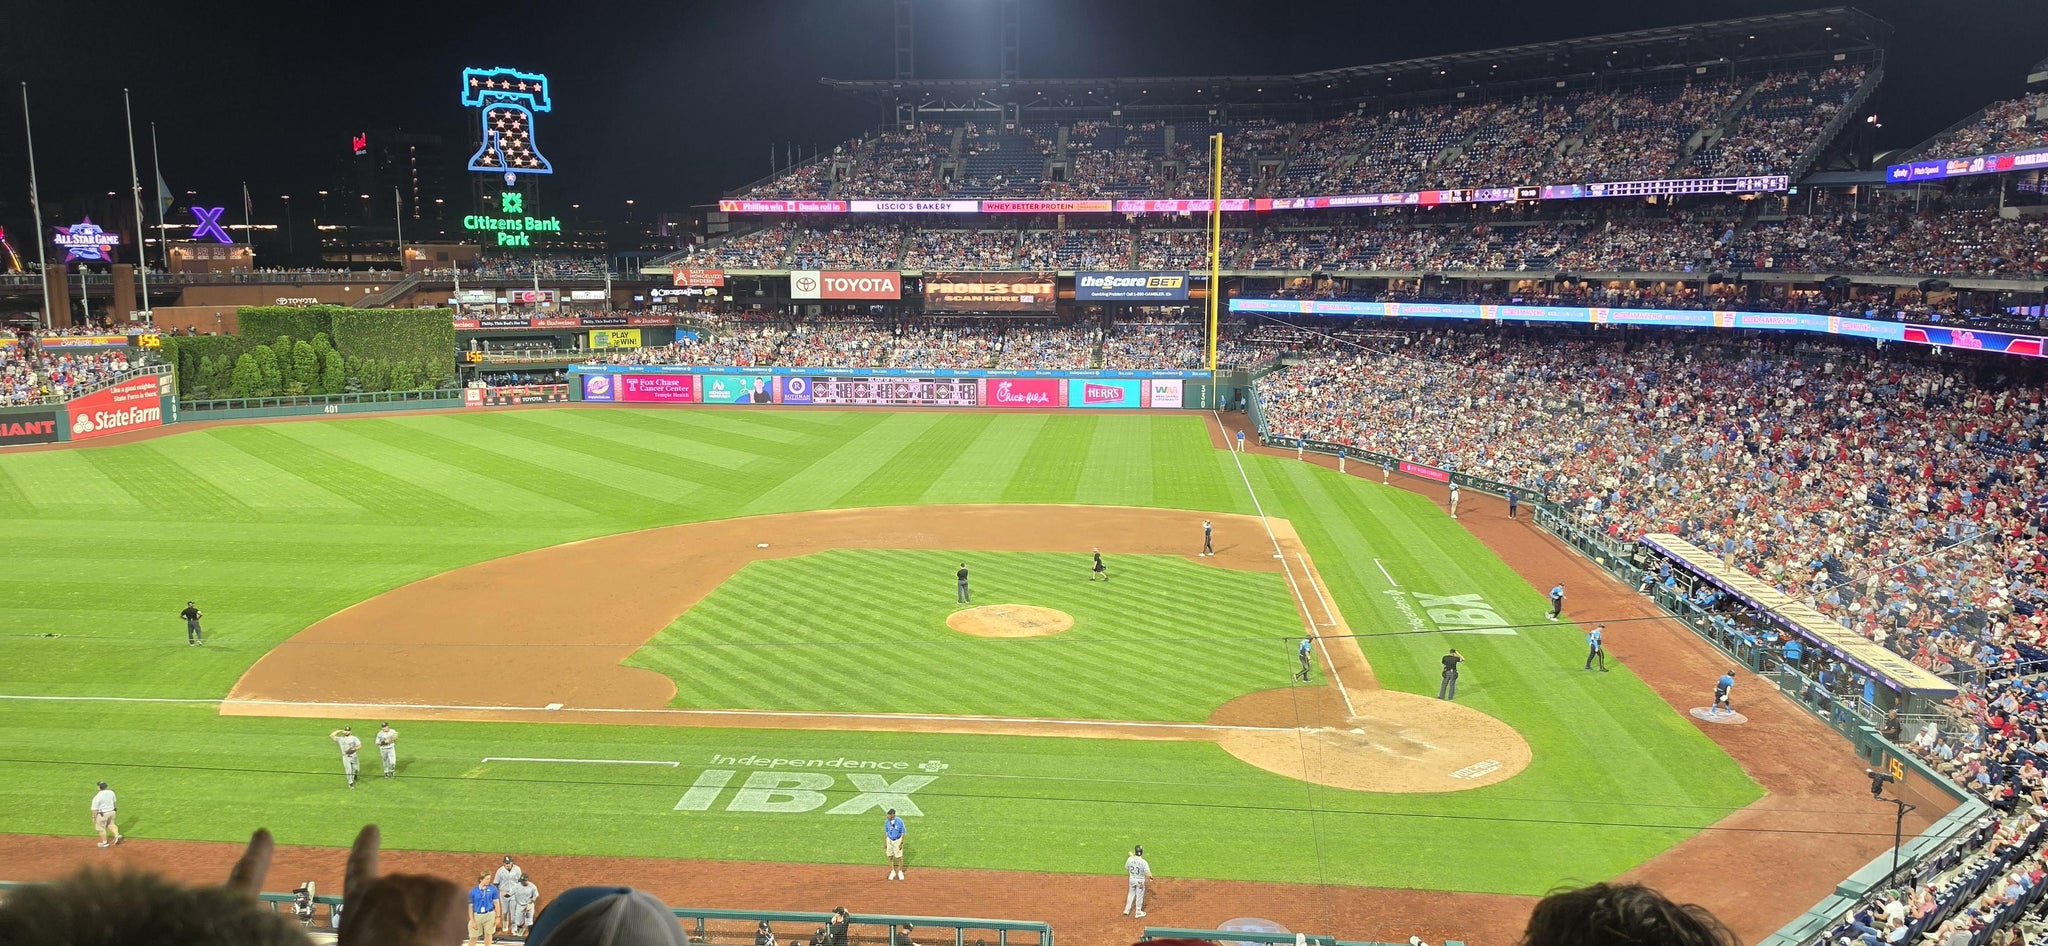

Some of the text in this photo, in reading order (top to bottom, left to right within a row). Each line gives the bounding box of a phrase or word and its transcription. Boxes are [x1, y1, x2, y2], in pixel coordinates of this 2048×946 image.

[742, 202, 783, 211] Phillies win
[464, 215, 561, 231] Citizens Bank
[94, 234, 119, 245] GAME
[498, 232, 530, 246] Park
[824, 278, 895, 292] TOYOTA
[1080, 276, 1180, 288] theScore BET
[925, 283, 1052, 294] PHONES OUT
[137, 334, 160, 347] 1:56
[466, 352, 483, 362] 1:56
[110, 386, 120, 394] Like
[125, 385, 136, 393] good
[137, 383, 157, 392] neighbor,
[1088, 388, 1119, 399] HERR'S
[996, 386, 1050, 404] Chick-fil-A
[324, 405, 338, 413] 401
[0, 420, 55, 436] IANT
[1411, 591, 1519, 636] IBX
[708, 754, 910, 772] Independence
[674, 770, 940, 817] IBX
[1130, 866, 1140, 875] 23
